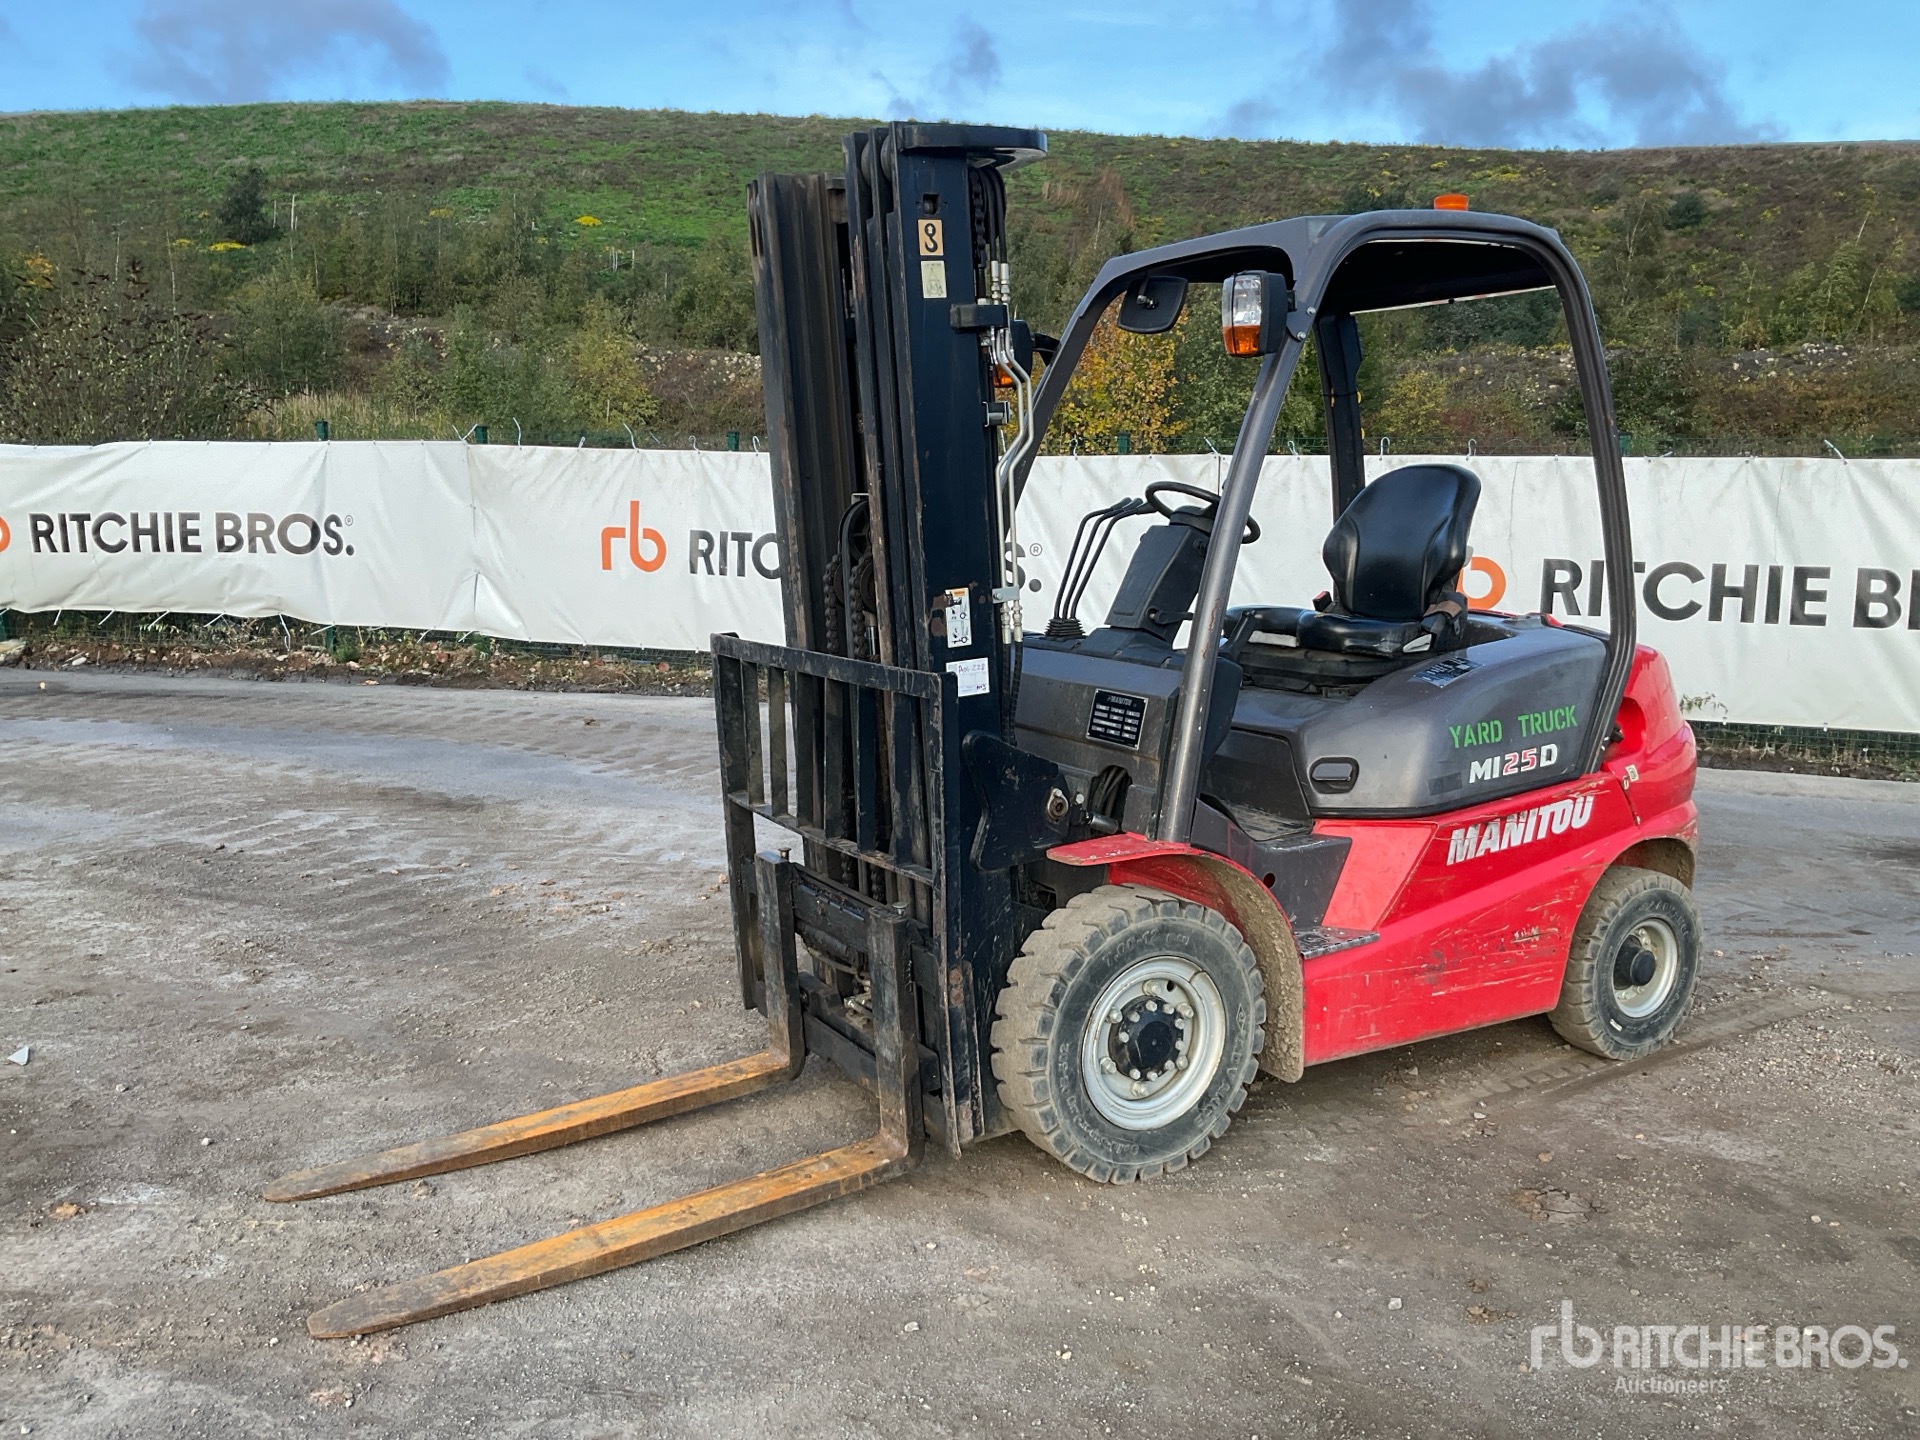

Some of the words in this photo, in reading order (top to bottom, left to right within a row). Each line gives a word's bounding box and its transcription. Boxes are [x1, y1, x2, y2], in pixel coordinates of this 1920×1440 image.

[28, 511, 202, 554] RITCHIE
[215, 512, 355, 557] BROS.
[601, 500, 667, 572] rb
[689, 529, 782, 580] RITC
[1853, 567, 1920, 631] B
[1449, 719, 1503, 749] YARD
[1518, 705, 1578, 738] TRUCK
[1469, 743, 1558, 783] MI25D
[1446, 795, 1594, 866] MANITOU
